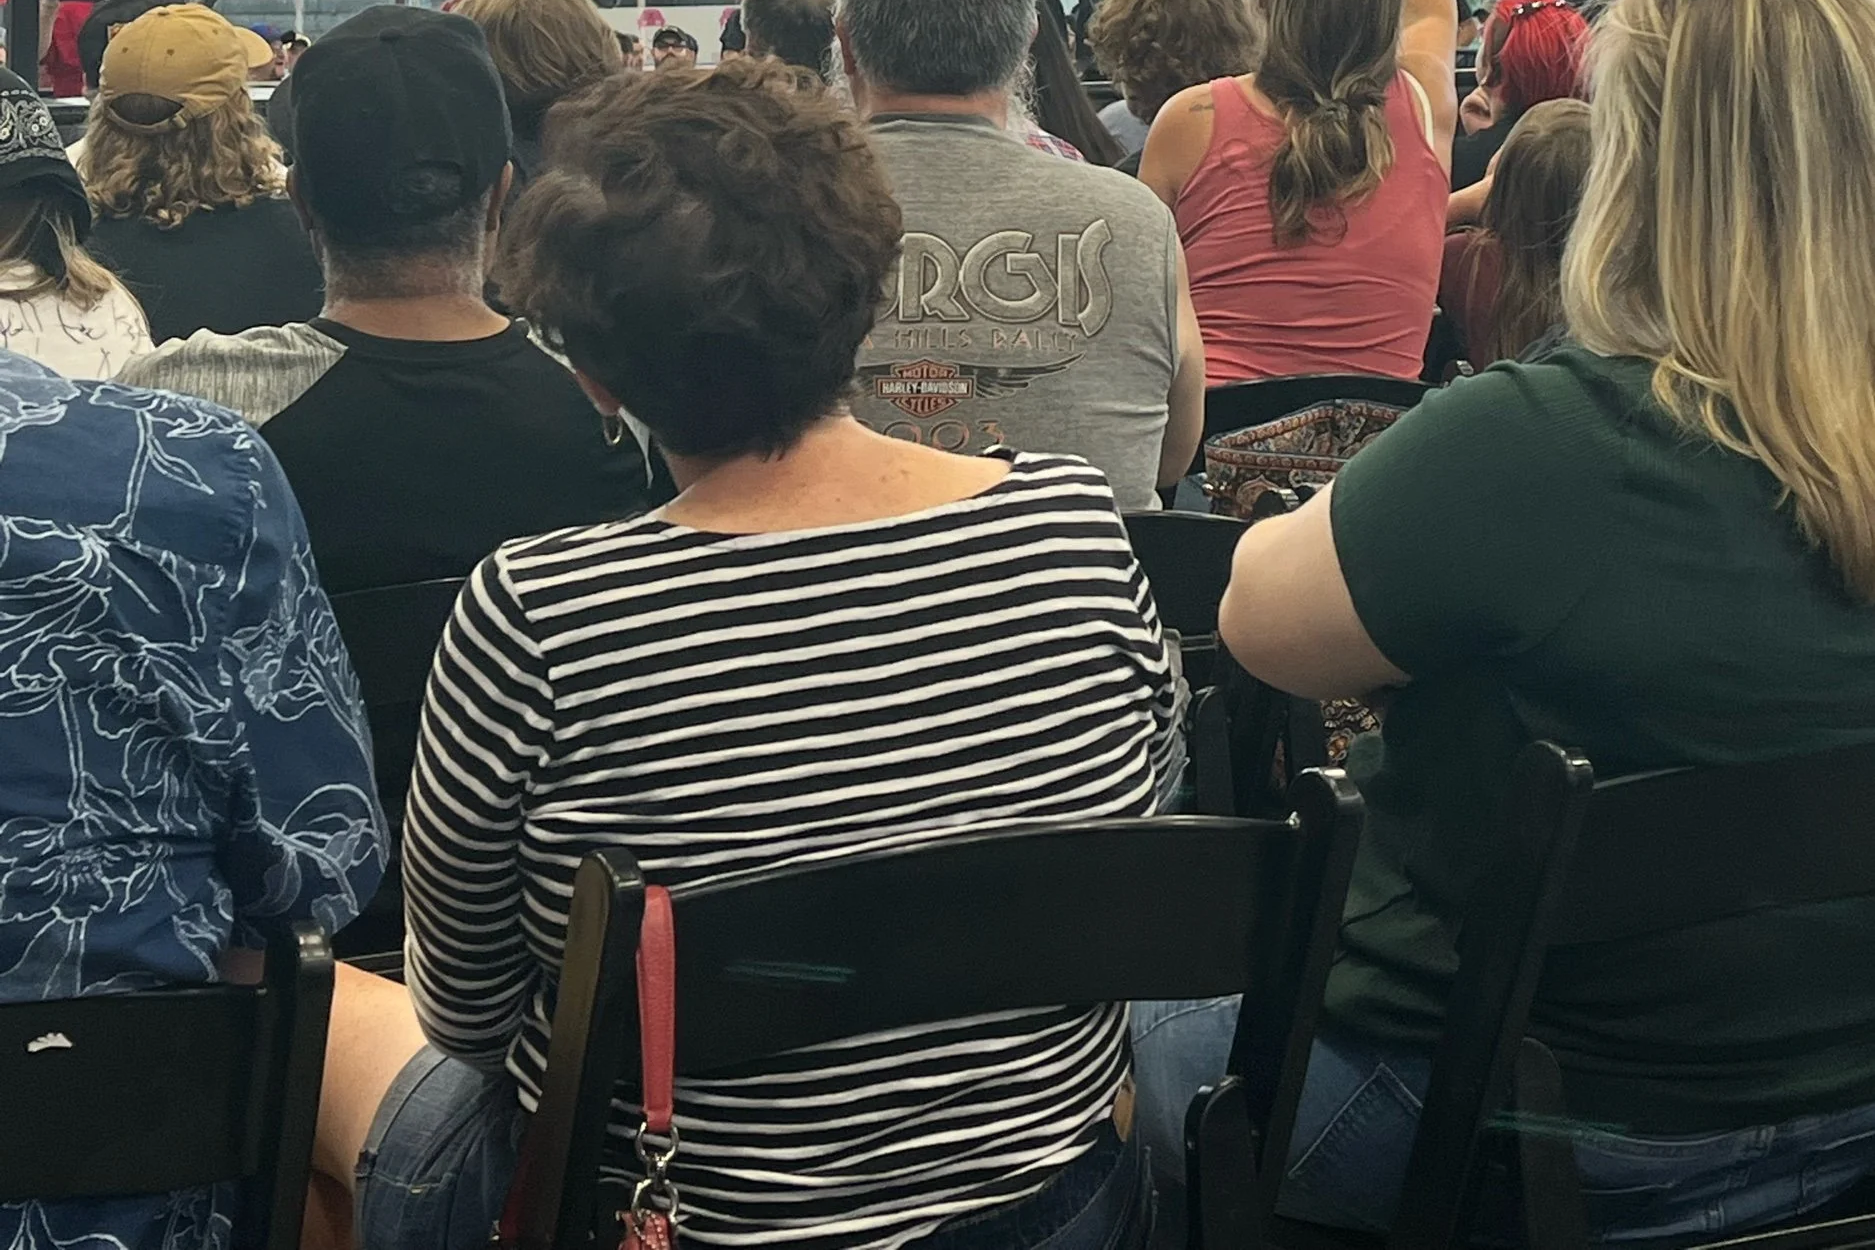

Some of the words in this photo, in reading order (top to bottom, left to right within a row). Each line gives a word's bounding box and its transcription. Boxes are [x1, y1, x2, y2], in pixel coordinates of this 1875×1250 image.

[878, 218, 1112, 338] RGIS
[895, 328, 972, 350] HILLS
[991, 327, 1078, 352] RALLY
[902, 365, 948, 379] MOTOR
[881, 380, 968, 395] HARLEY-DAVIDSON
[901, 397, 947, 412] CYCLES
